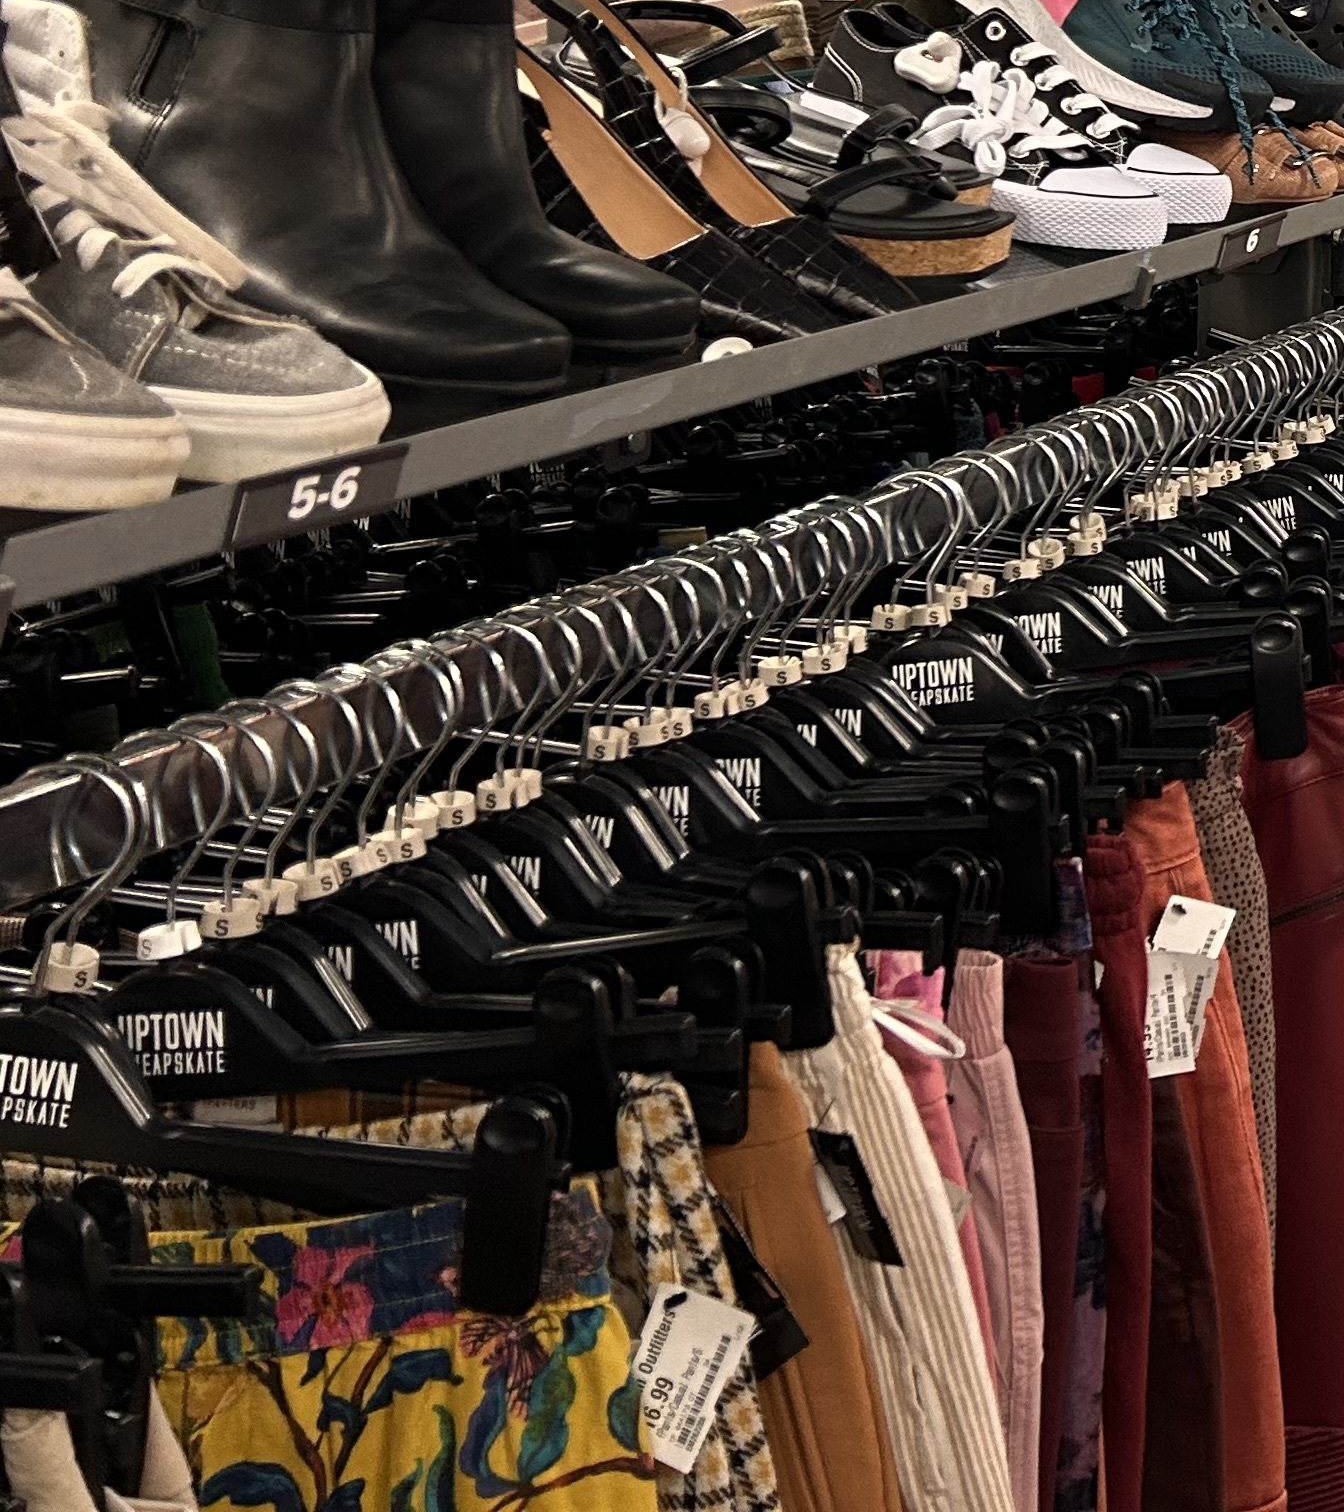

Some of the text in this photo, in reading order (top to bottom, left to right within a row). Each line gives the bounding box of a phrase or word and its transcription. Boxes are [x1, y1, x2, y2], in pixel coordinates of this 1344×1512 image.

[1245, 230, 1260, 253] 6
[1220, 475, 1227, 486] S
[1226, 469, 1233, 480] S
[286, 466, 362, 521] 5-6
[1091, 543, 1099, 554] S
[1045, 558, 1054, 569] S
[1012, 566, 1021, 578] S
[983, 583, 991, 596] S
[953, 596, 962, 607] S
[884, 617, 894, 630] S
[929, 611, 939, 624] S
[821, 657, 831, 672] S
[776, 671, 788, 685] S
[744, 694, 756, 708] S
[700, 702, 710, 717] S
[673, 721, 684, 737] S
[629, 731, 640, 746] S
[594, 745, 606, 760] S
[486, 792, 497, 810] S
[452, 809, 464, 826] S
[376, 847, 388, 864] S
[401, 842, 413, 859] S
[340, 861, 353, 879] S
[321, 875, 333, 892] S
[215, 918, 229, 937] S
[141, 938, 153, 958] S
[73, 970, 88, 989] S
[136, 1049, 226, 1077] EAPSKATE
[0, 1052, 78, 1102] TOWN
[0, 1098, 72, 1130] PSKATE
[638, 1310, 676, 1375] Outfitters
